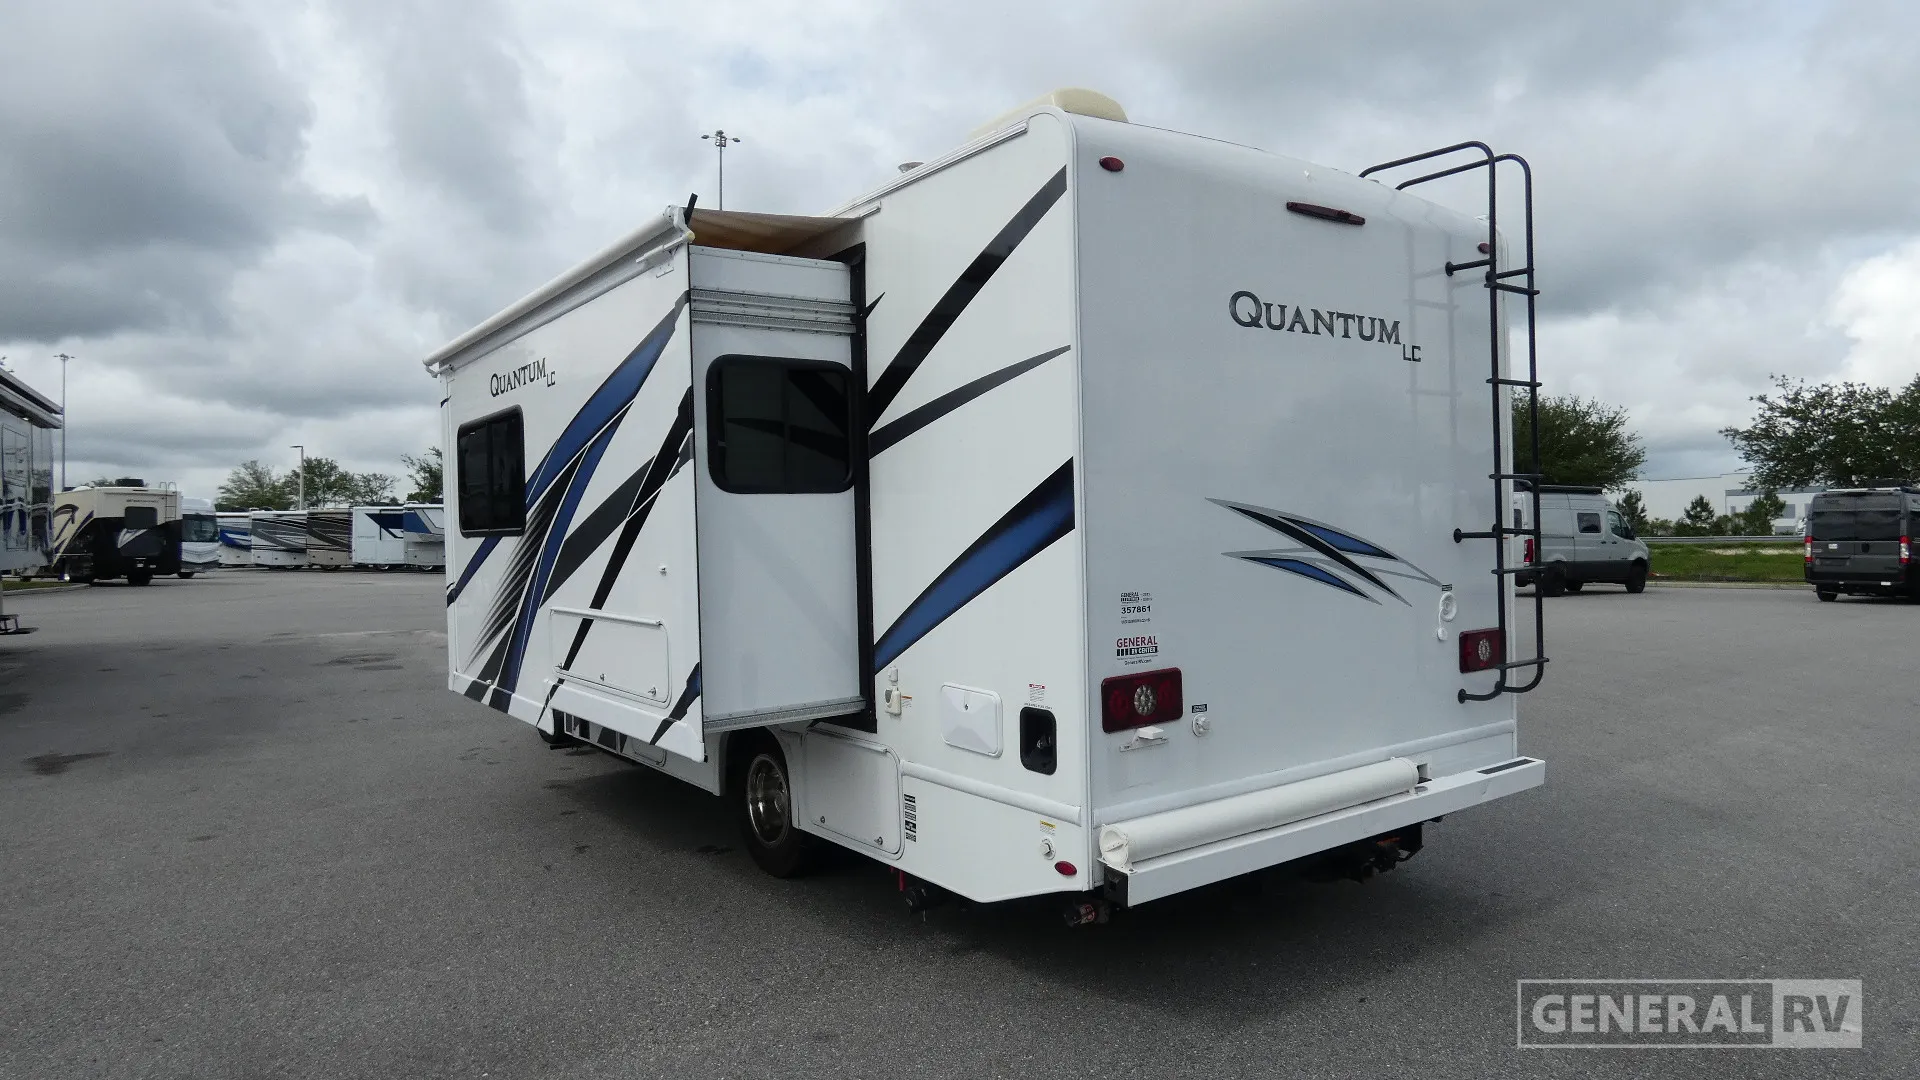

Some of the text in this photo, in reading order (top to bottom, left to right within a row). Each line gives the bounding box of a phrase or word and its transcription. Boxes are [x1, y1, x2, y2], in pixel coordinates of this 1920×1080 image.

[1228, 290, 1422, 362] QUANTUM LC
[490, 357, 555, 397] QUANTUM LC
[1121, 606, 1151, 614] 357861
[1116, 636, 1158, 648] GENERAL
